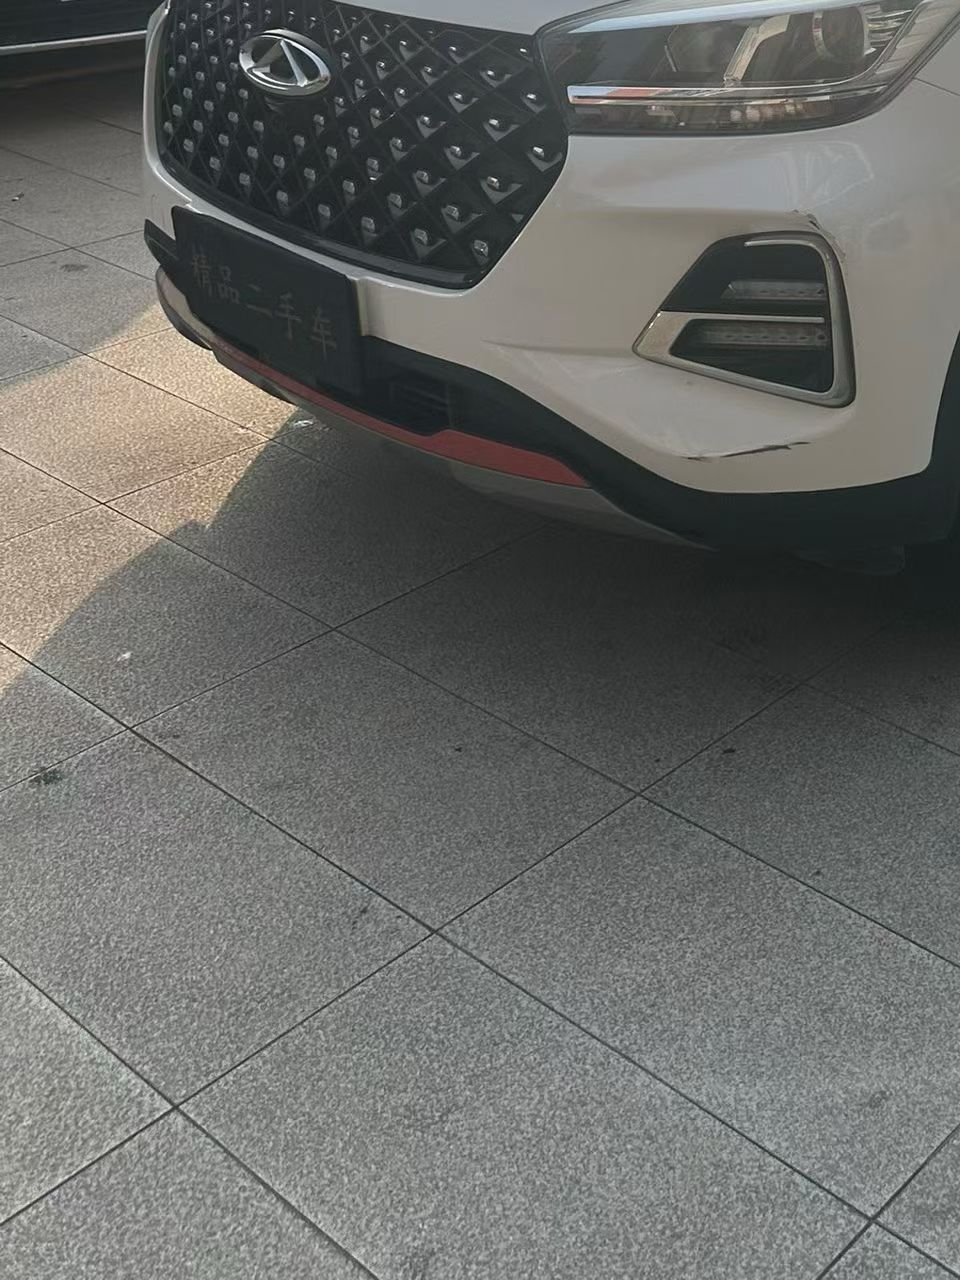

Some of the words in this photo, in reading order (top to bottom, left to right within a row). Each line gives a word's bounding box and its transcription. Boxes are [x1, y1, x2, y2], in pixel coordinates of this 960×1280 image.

[190, 252, 338, 360] 精品二手车
